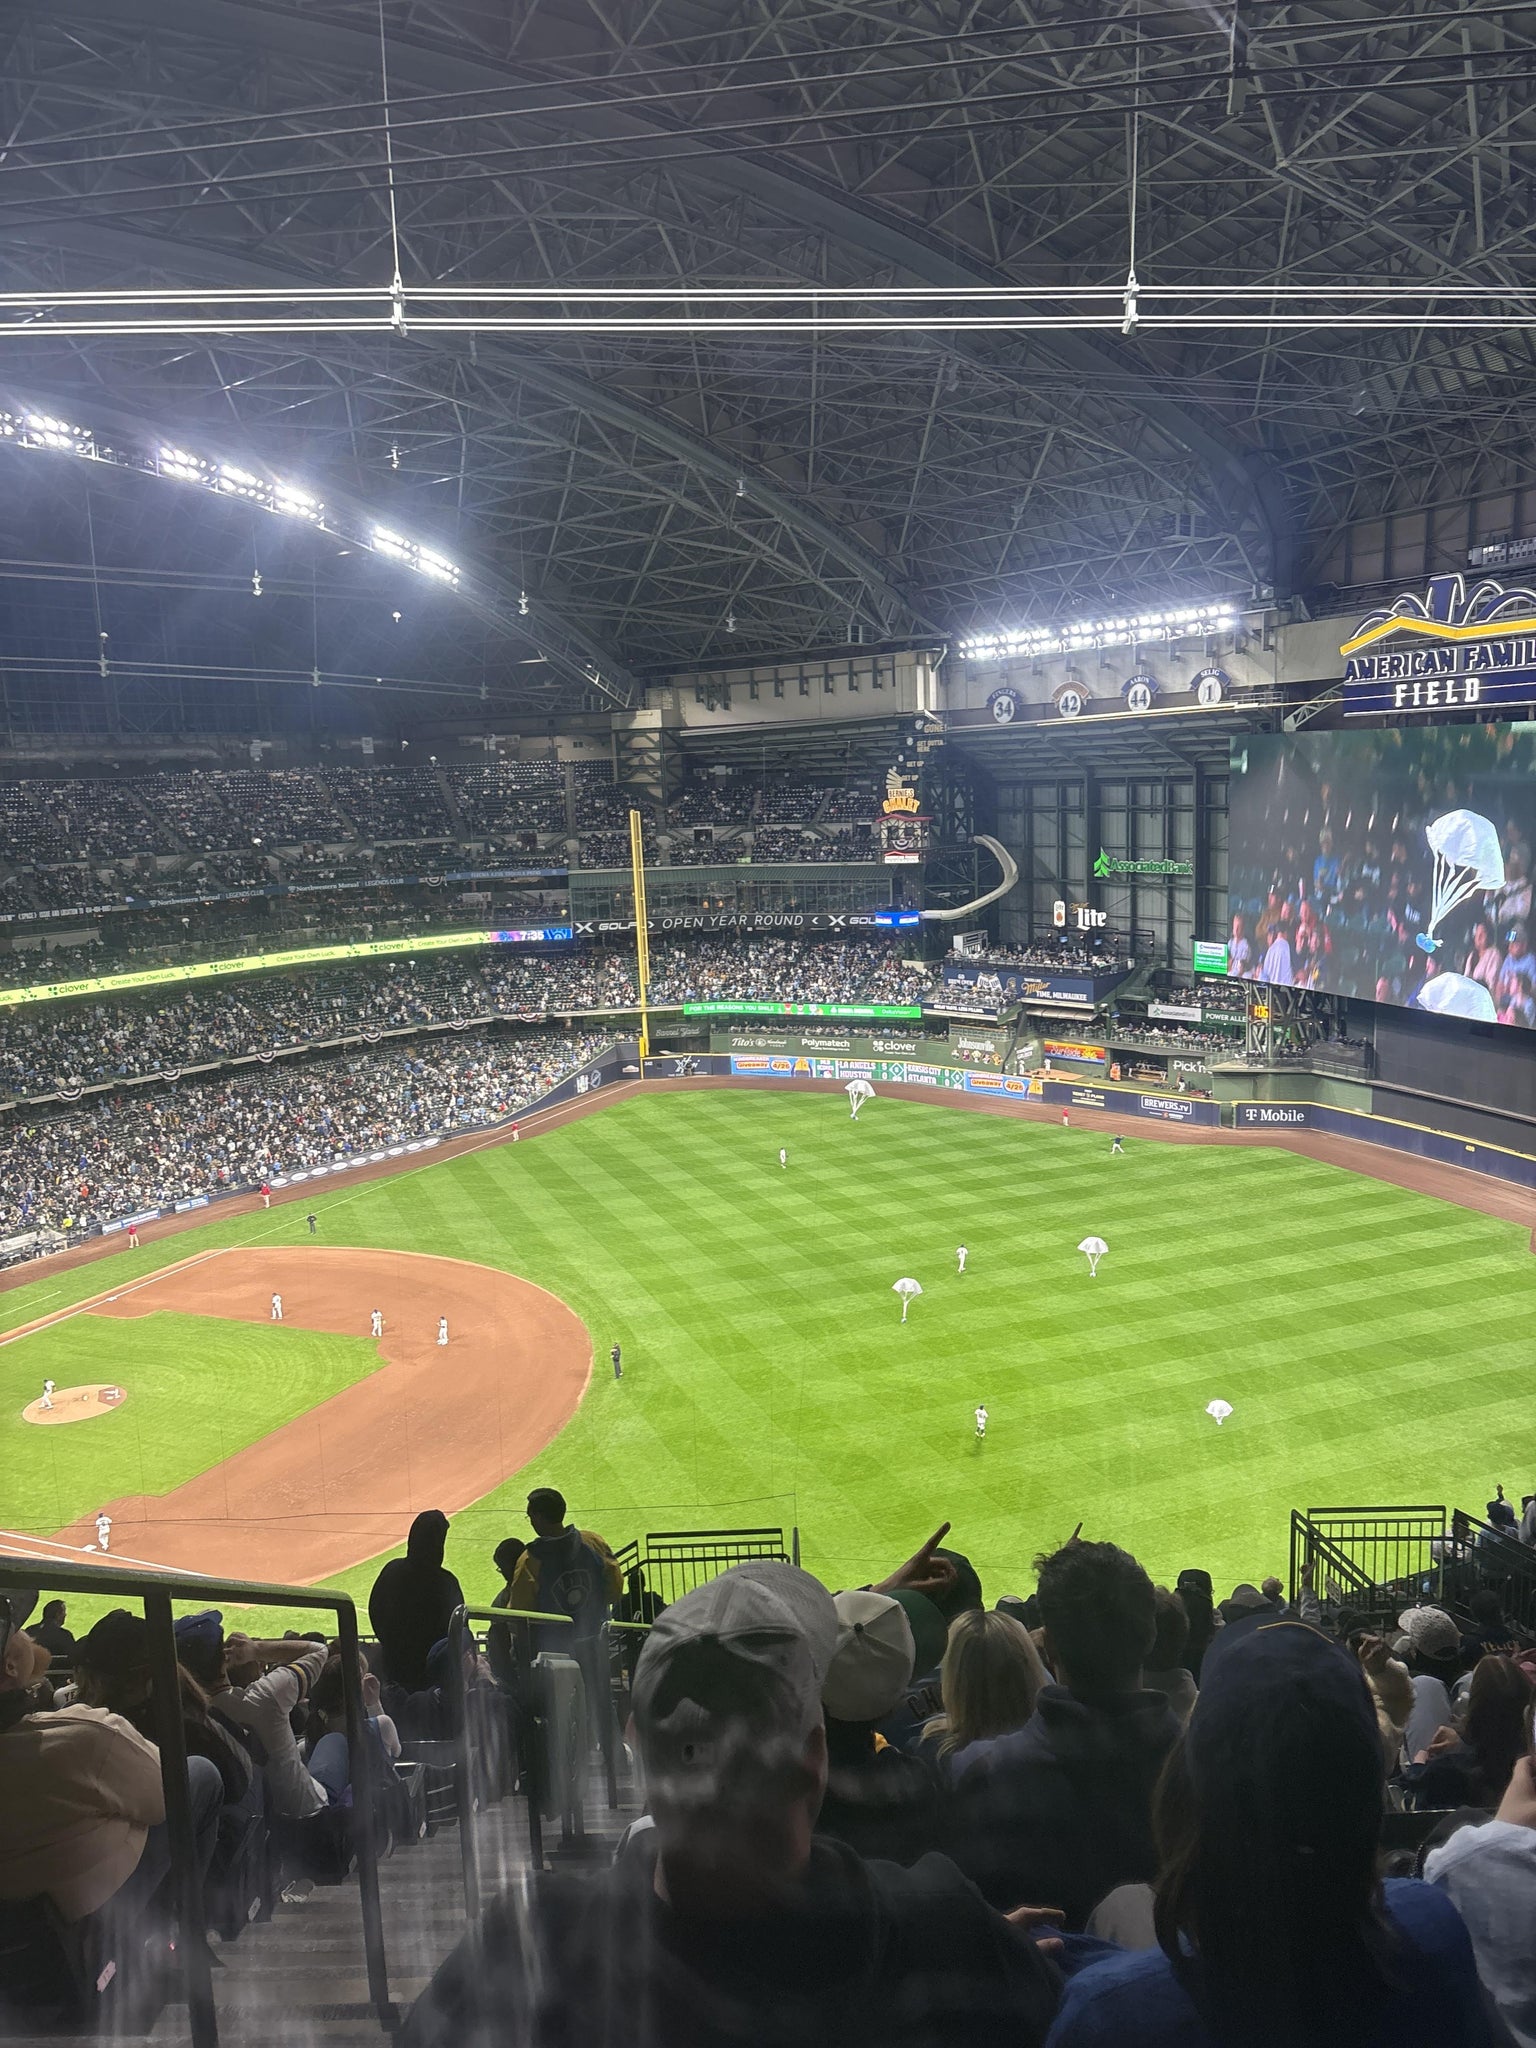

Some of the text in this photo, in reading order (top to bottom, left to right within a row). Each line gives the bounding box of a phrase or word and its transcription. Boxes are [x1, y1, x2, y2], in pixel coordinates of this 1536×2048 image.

[1345, 647, 1458, 683] AMERICAN
[1200, 668, 1220, 678] SELIG
[1129, 675, 1150, 686] AARON
[1131, 689, 1148, 707] 44
[1206, 684, 1213, 702] 1
[1394, 677, 1480, 708] FIELD
[996, 701, 1012, 719] 34
[1061, 696, 1079, 713] 42
[883, 797, 920, 813] CHALET
[296, 884, 337, 892] Northwestern
[158, 897, 198, 906] Northwestern
[200, 893, 220, 901] Mutual
[575, 922, 594, 933] X
[662, 917, 703, 929] OPEN
[709, 915, 747, 926] YEAR
[754, 914, 804, 926] ROUND
[828, 915, 847, 926] X
[850, 916, 876, 925] GOL
[1077, 908, 1107, 930] Lite
[59, 982, 89, 994] clover
[111, 978, 131, 986] Create
[132, 976, 146, 984] Your
[146, 974, 160, 982] Own
[219, 961, 244, 971] clover
[379, 943, 404, 951] clover
[1021, 982, 1051, 995] Miller
[1052, 991, 1088, 1001] MILWAUKEE
[1206, 1013, 1251, 1022] POWER ALLE
[731, 1037, 754, 1047] Tito's
[801, 1038, 850, 1048] Polymatech
[884, 1041, 916, 1051] clover
[957, 1037, 995, 1052] Johnsonville
[850, 1062, 876, 1070] ANGELS
[929, 1067, 941, 1075] CITY
[840, 1071, 872, 1079] HOUSTON
[908, 1074, 936, 1084] ATLANTA
[971, 1079, 1001, 1087] Giveaway
[1145, 1097, 1189, 1112] BREWERS.TV
[1260, 1109, 1305, 1122] Mobile
